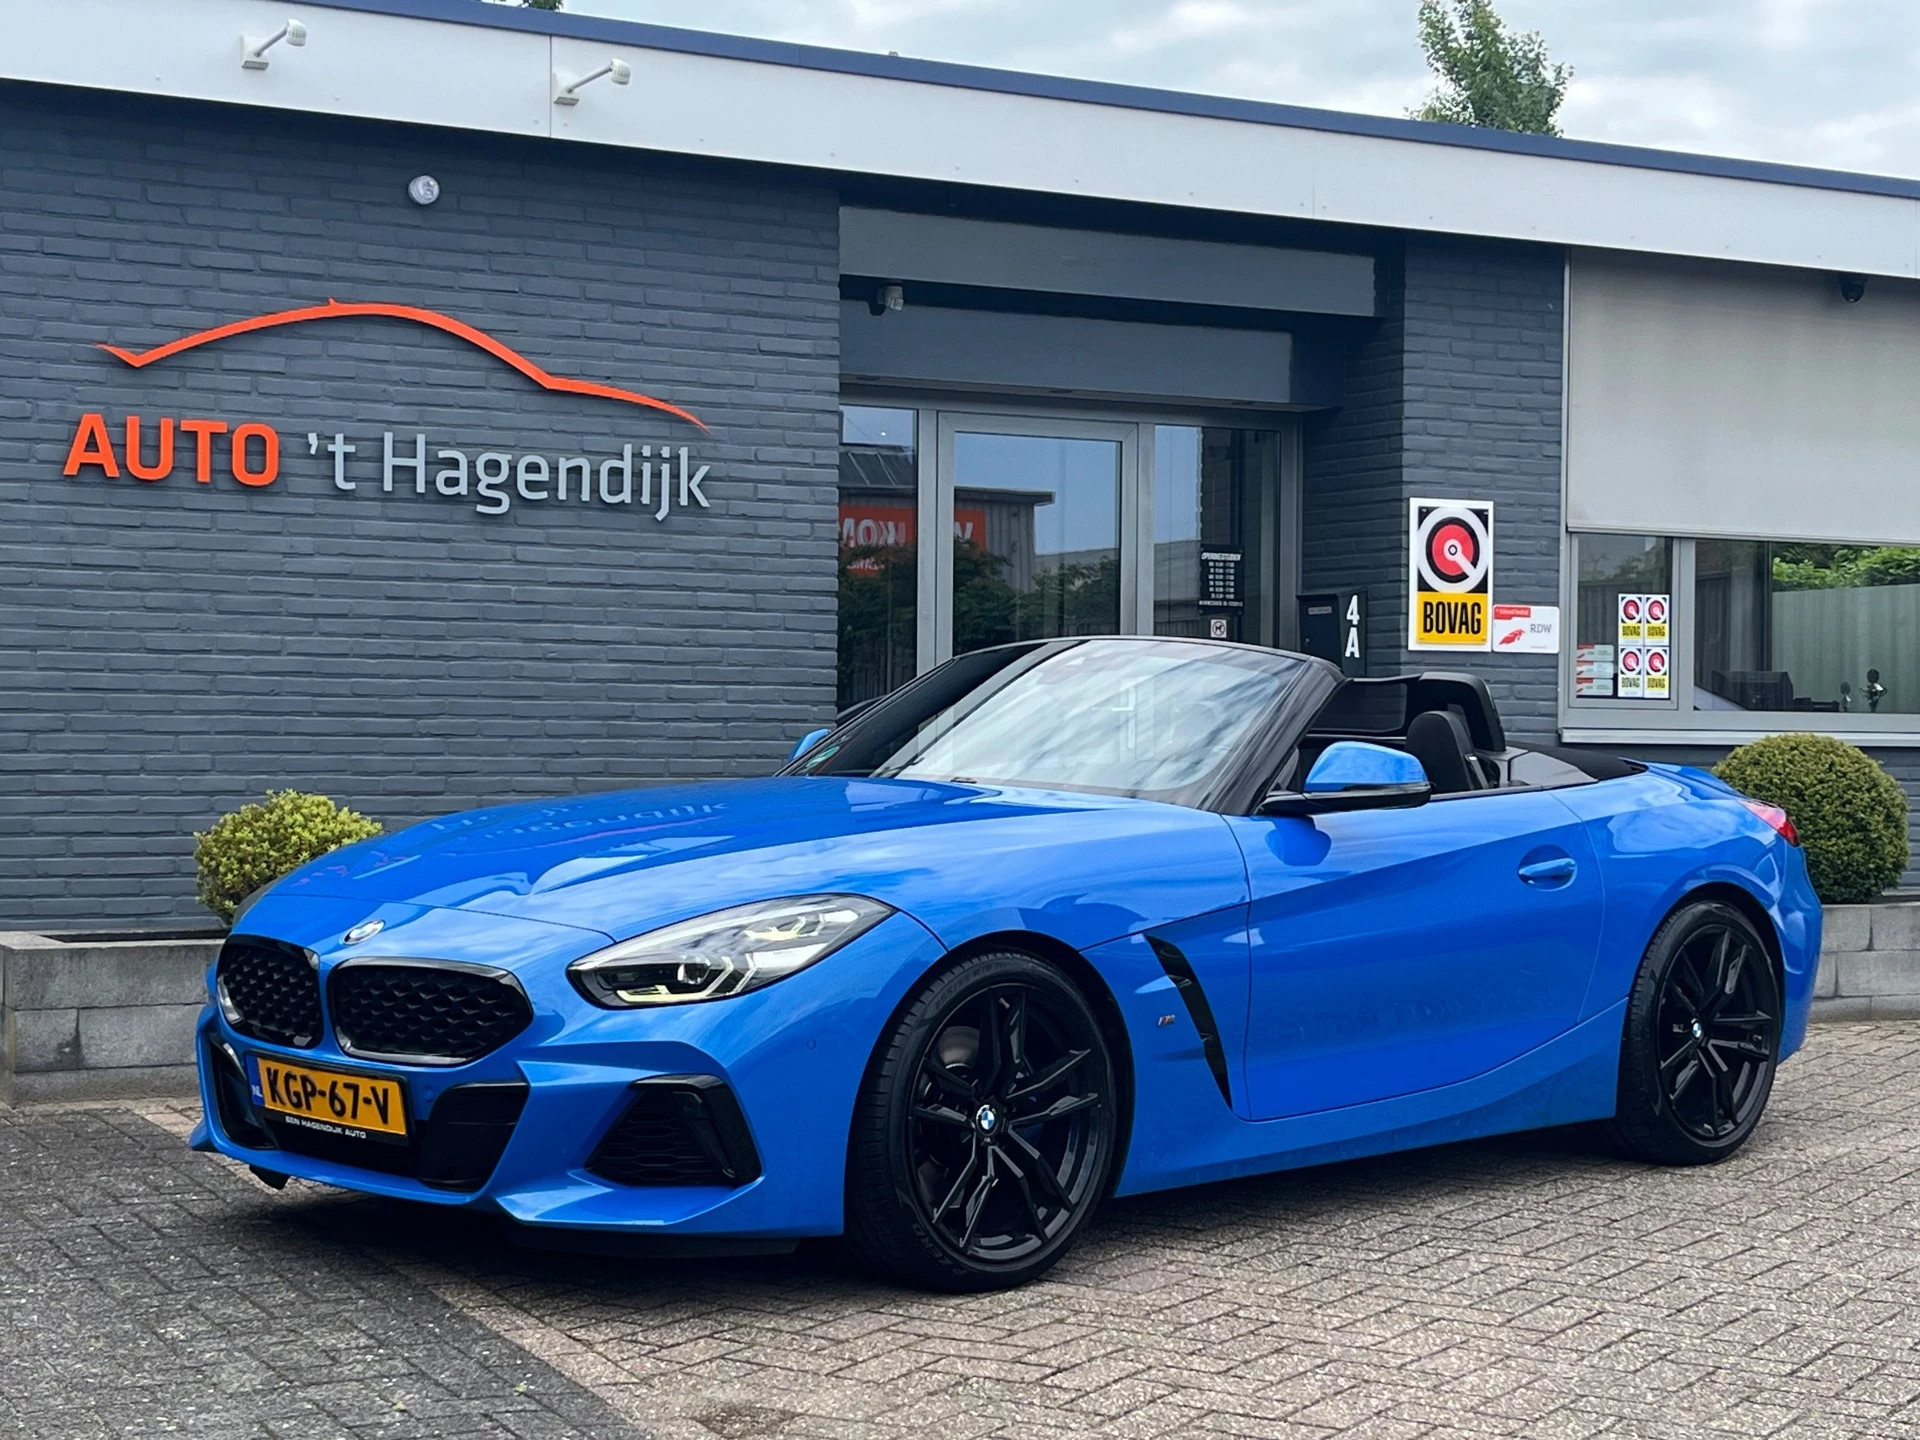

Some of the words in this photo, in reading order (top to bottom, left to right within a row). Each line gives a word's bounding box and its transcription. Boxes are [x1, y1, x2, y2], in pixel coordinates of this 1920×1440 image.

[63, 412, 280, 487] AUTO
[308, 432, 357, 490] 't
[383, 431, 712, 522] Hagendijk
[1346, 594, 1360, 625] 4
[1423, 601, 1482, 634] BOVAG
[1345, 627, 1360, 658] A
[1530, 623, 1552, 633] RDW
[266, 1066, 389, 1125] KGP-67-V
[345, 1128, 366, 1138] AUTO
